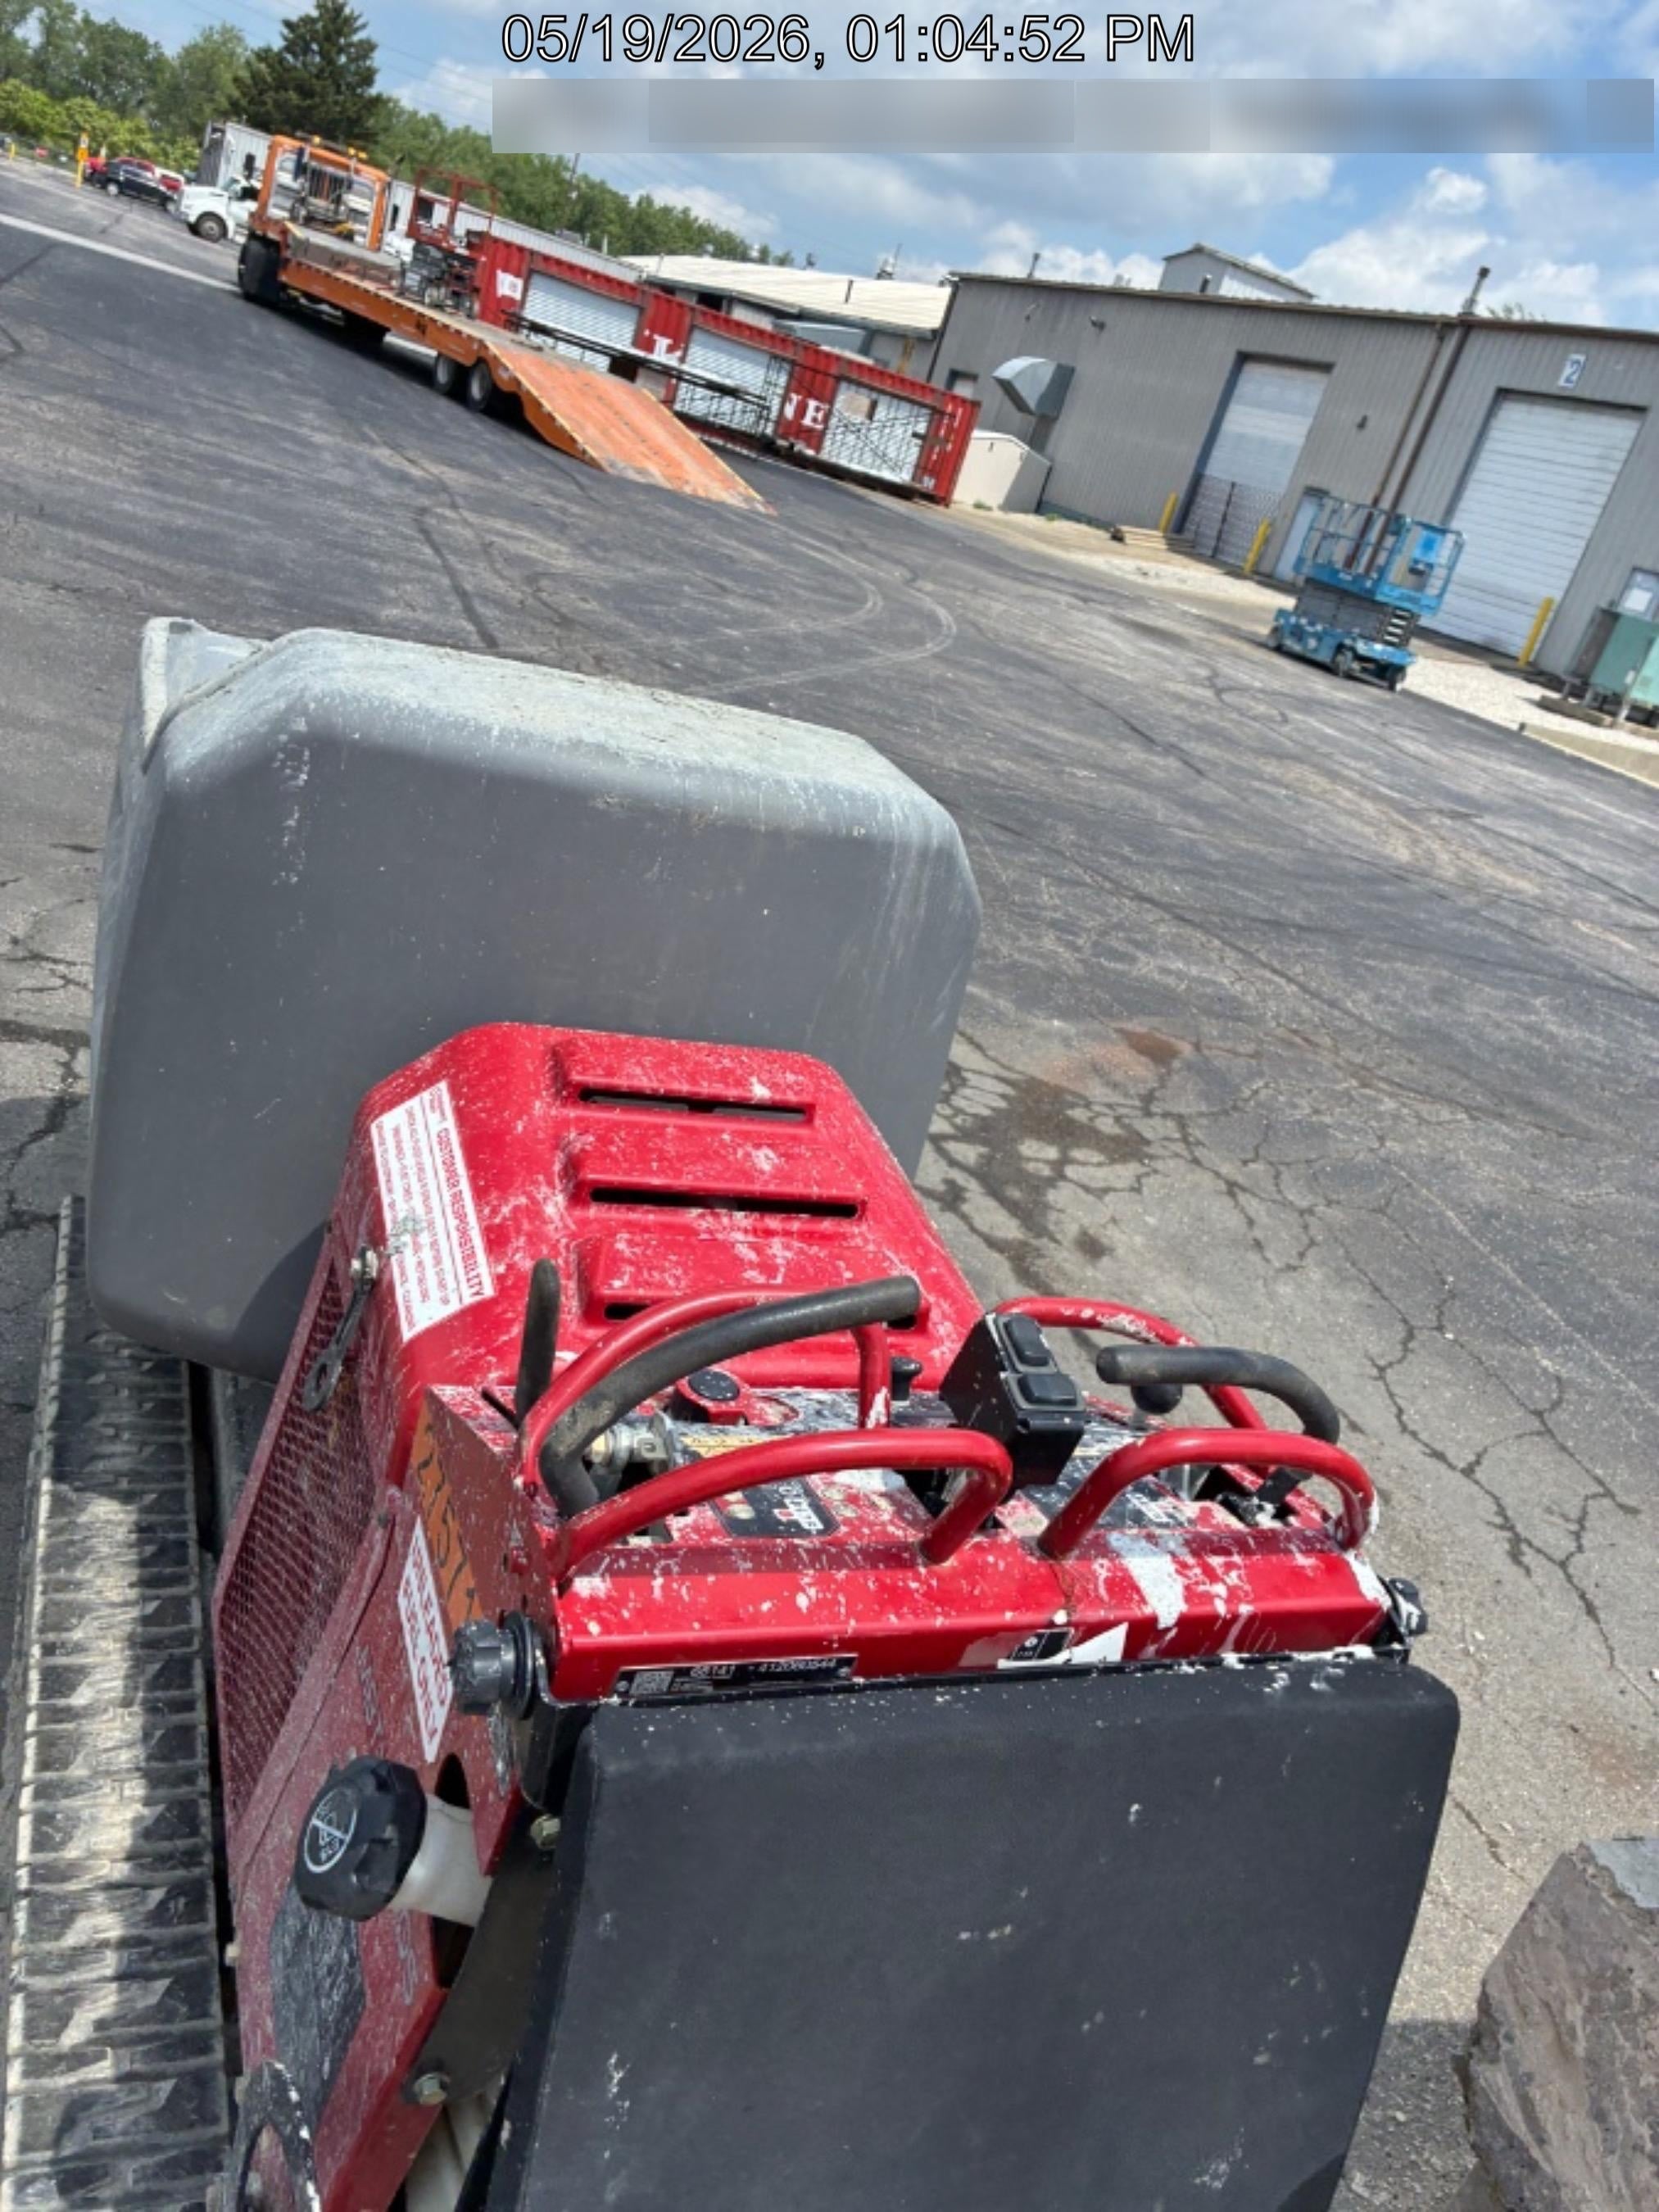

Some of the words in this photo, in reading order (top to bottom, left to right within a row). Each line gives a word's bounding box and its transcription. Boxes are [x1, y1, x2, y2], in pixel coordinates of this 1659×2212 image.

[1563, 359, 1582, 385] 2
[436, 1127, 460, 1189] CUSTOMER
[449, 1190, 485, 1297] RESPONSIBILITY
